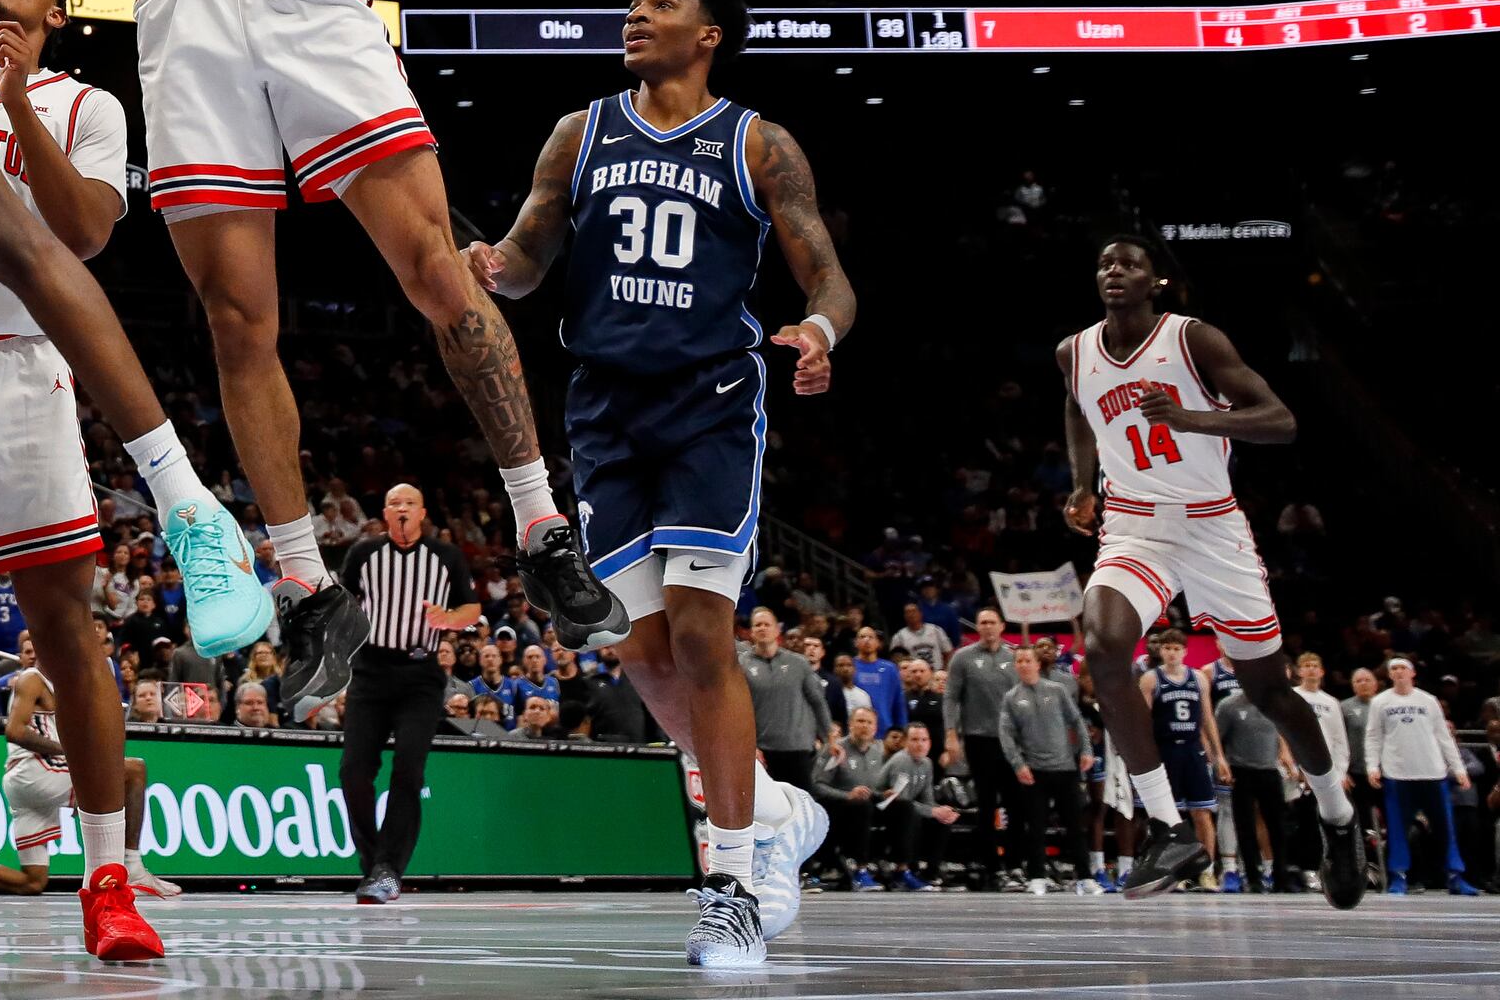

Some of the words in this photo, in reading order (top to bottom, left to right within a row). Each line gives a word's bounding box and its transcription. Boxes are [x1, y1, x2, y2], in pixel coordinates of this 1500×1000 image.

[539, 20, 584, 40] Ohio
[777, 19, 832, 39] State
[981, 20, 996, 39] 7
[1076, 18, 1124, 40] Uzan
[1224, 27, 1243, 47] 4
[1282, 23, 1301, 44] 3
[1408, 13, 1427, 34] 2
[591, 159, 723, 209] BRIGHAM
[608, 196, 697, 269] 30
[610, 275, 694, 309] YOUNG
[1125, 424, 1183, 471] 14
[0, 606, 11, 623] 3
[1174, 700, 1191, 721] 6
